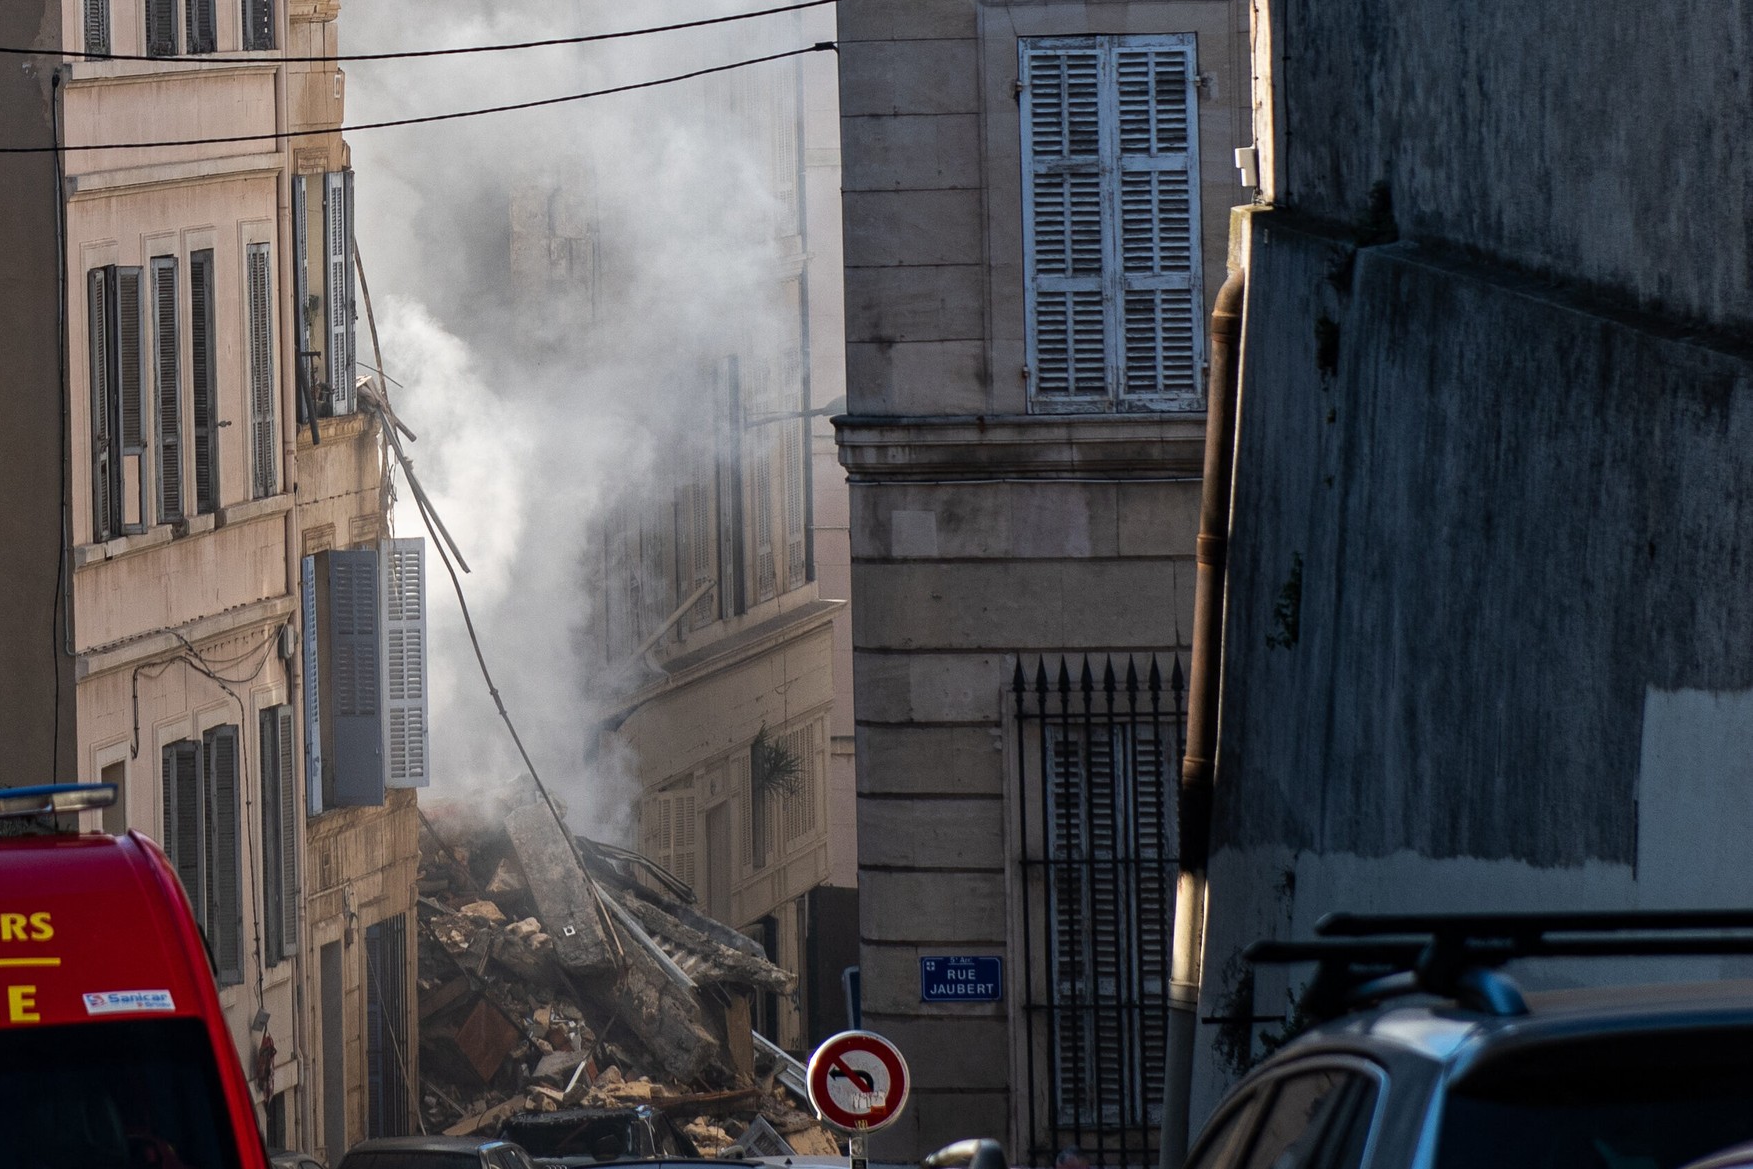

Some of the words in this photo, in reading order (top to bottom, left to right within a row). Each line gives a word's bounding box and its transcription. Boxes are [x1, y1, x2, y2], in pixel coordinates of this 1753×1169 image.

[947, 969, 976, 980] RUE
[930, 984, 994, 994] JAUBERT
[108, 993, 167, 1003] Sanicar
